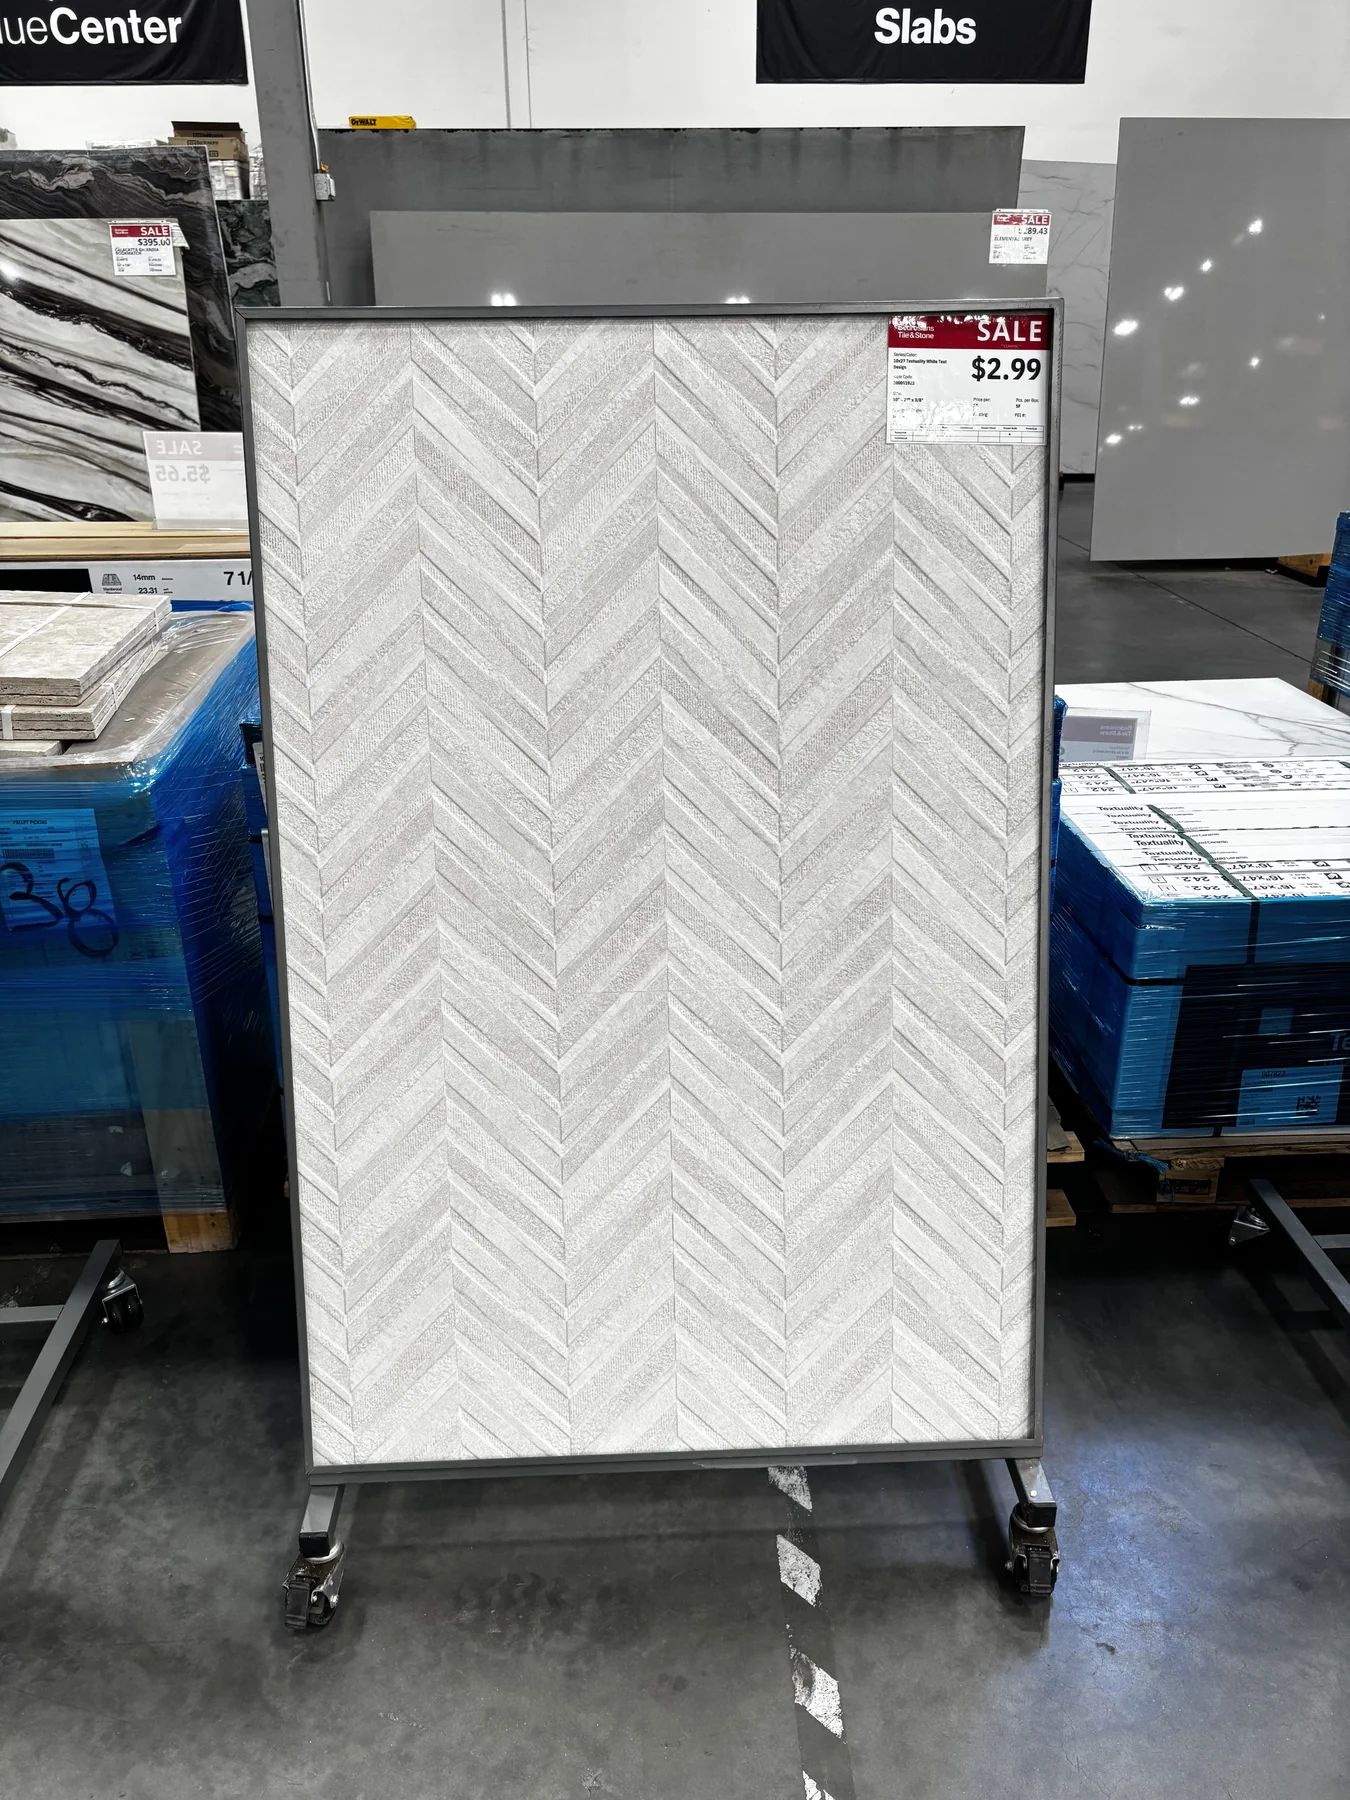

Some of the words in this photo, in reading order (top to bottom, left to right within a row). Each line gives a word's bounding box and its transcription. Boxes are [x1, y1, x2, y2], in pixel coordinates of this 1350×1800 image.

[0, 6, 182, 45] ueCenter
[874, 7, 977, 45] Slabs
[140, 226, 169, 236] SALE
[1021, 215, 1049, 225] SALE
[137, 238, 171, 246] $395.00
[977, 319, 1042, 342] SALE
[971, 355, 1042, 382] $2.99
